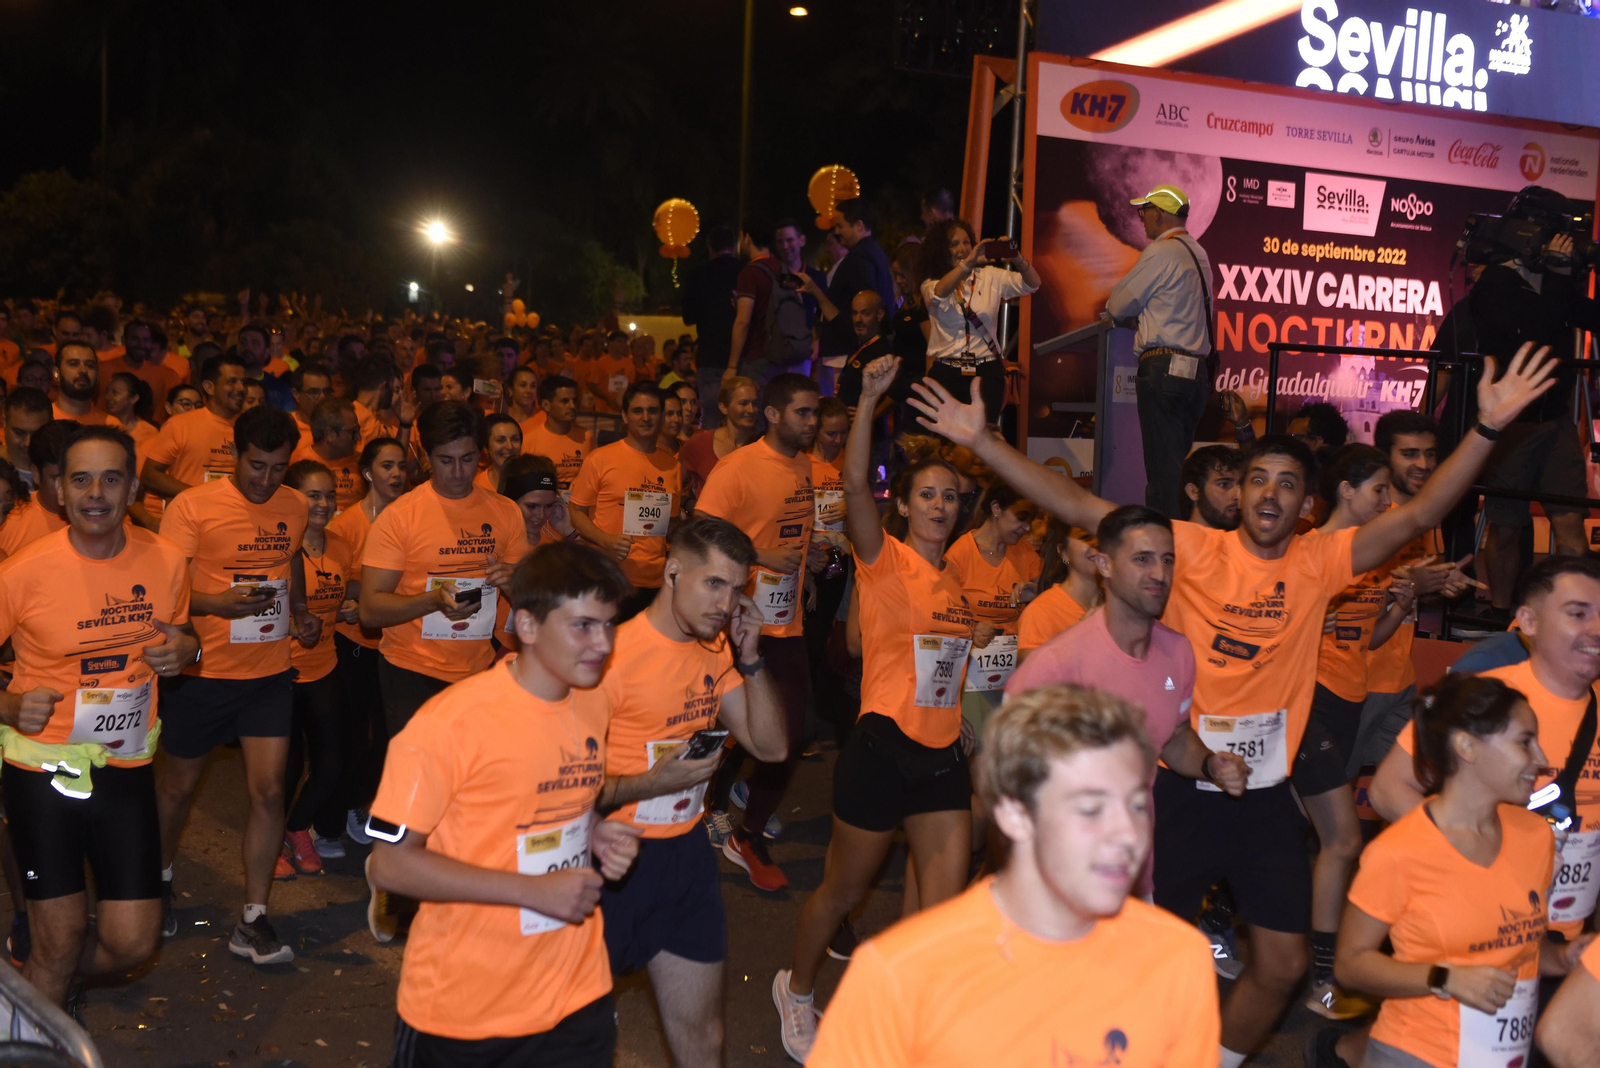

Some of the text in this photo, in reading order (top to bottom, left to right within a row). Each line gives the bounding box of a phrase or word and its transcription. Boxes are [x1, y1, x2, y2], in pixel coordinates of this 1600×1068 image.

[1156, 103, 1190, 122] ABC
[1206, 111, 1274, 138] Cruzcampo
[1285, 126, 1353, 145] TORRE SEVILLA
[1394, 134, 1436, 146] GRUPO Avisa
[1243, 178, 1260, 190] IMD
[1263, 236, 1407, 266] 30 de septiembre 2022
[1217, 264, 1444, 316] XXXIV CARRERA
[1216, 311, 1437, 363] NOCTURNA
[1215, 368, 1244, 393] del
[638, 506, 661, 519] 2940
[238, 544, 272, 552] SEVILLA
[457, 538, 496, 546] NOCTURNA
[438, 546, 476, 555] SEVILLA
[101, 603, 153, 616] NOCTURNA
[77, 615, 126, 630] SEVILLA
[932, 612, 960, 624] SEVILLA
[934, 660, 954, 678] 7580
[977, 654, 1013, 668] 17432
[94, 710, 142, 732] 20272
[666, 710, 700, 726] SEVILLA
[1226, 739, 1264, 758] 7581
[536, 778, 579, 794] SEVILLA
[1468, 934, 1524, 952] SEVILLA
